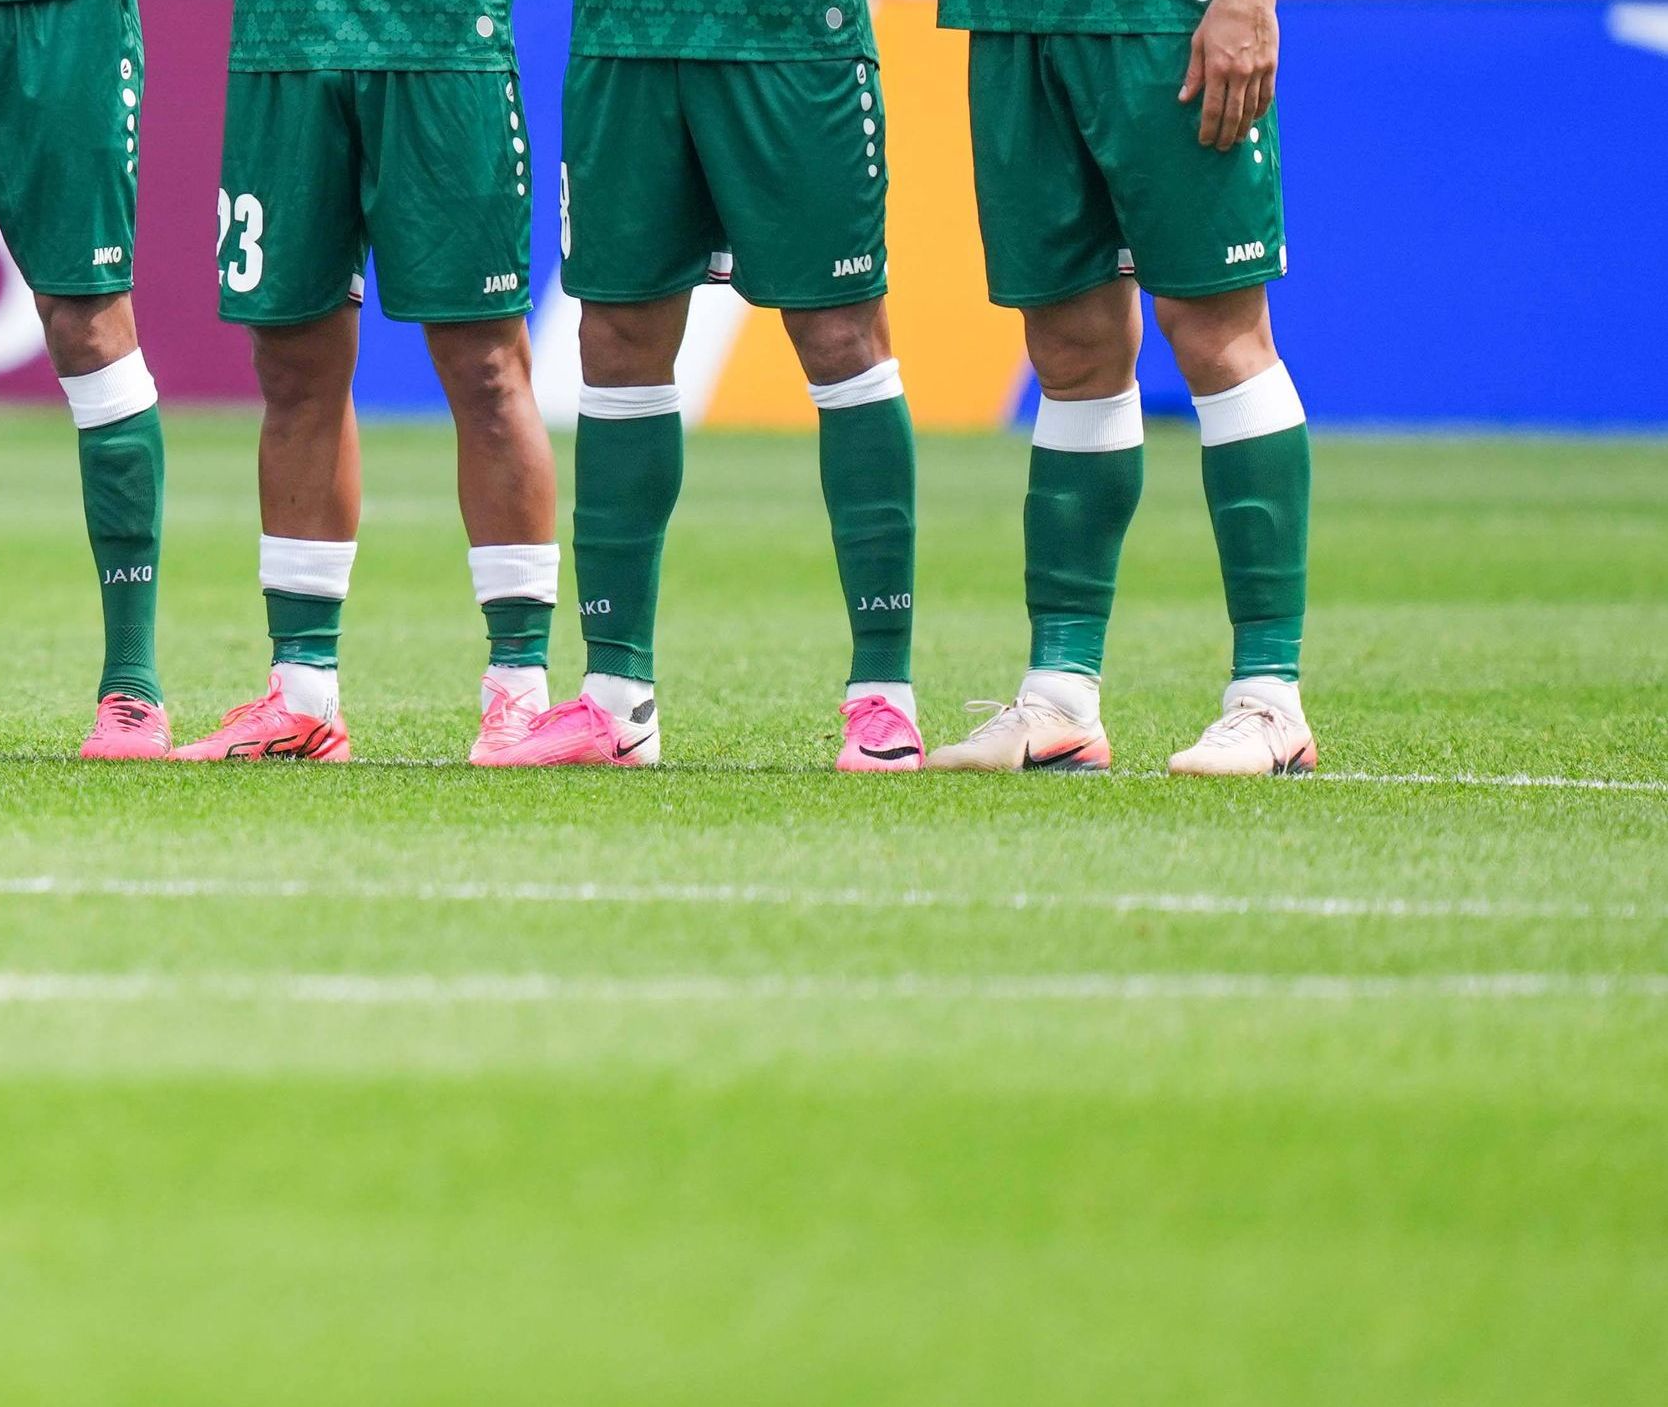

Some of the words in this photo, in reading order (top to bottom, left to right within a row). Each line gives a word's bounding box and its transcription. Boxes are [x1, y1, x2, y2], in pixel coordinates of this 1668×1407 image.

[92, 246, 122, 266] JAKO
[1225, 241, 1265, 265] JAKO
[832, 254, 873, 277] JAKO
[483, 272, 518, 294] JAKO
[104, 565, 152, 584] JAKO
[576, 599, 612, 615] AKO
[857, 593, 911, 611] JAKO
